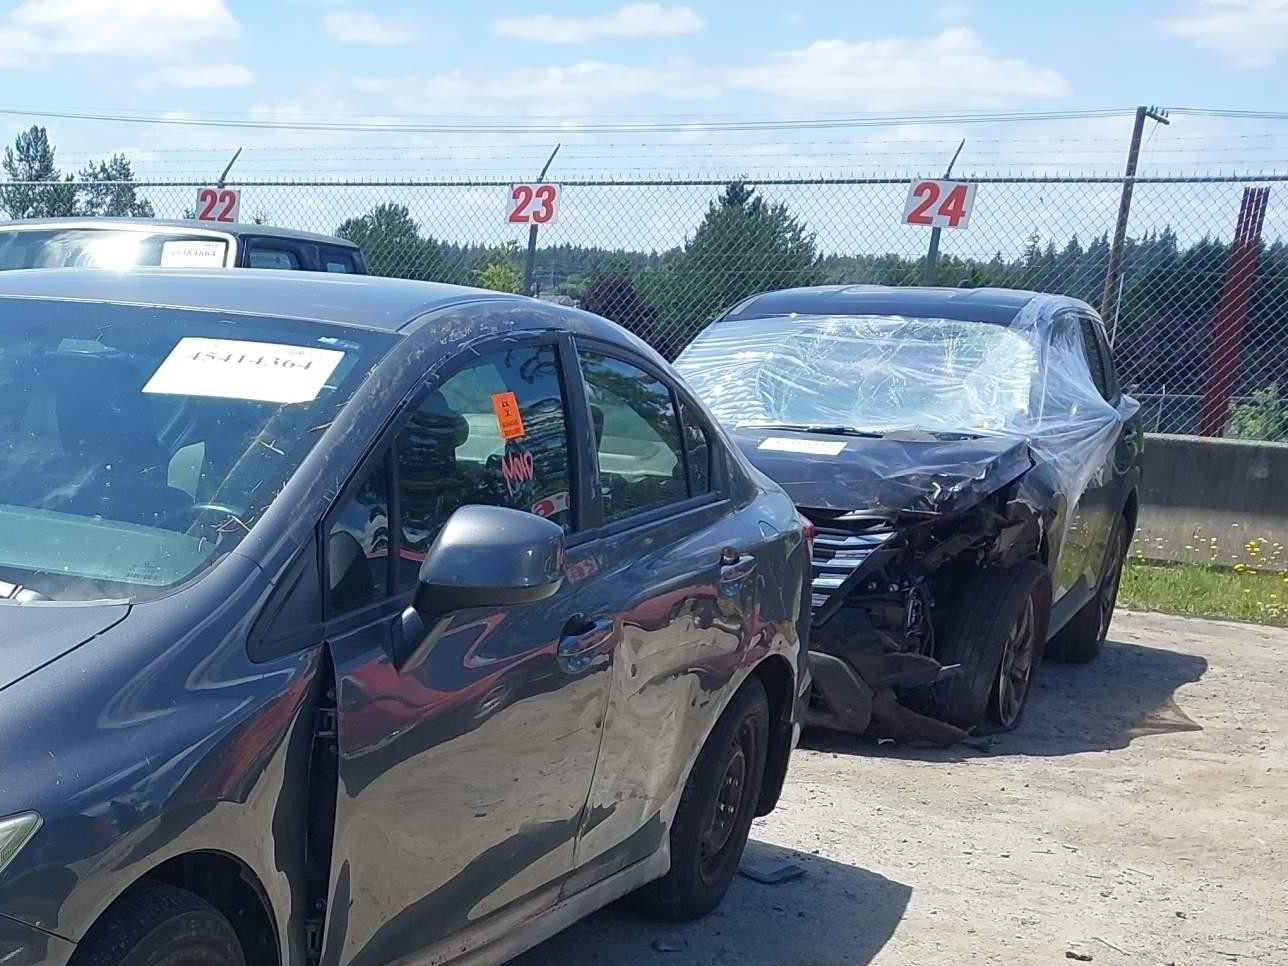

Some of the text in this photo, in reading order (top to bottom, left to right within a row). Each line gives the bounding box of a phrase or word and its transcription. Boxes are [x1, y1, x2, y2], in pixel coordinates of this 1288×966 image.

[199, 189, 236, 222] 22
[509, 185, 556, 223] 23
[907, 181, 968, 226] 24
